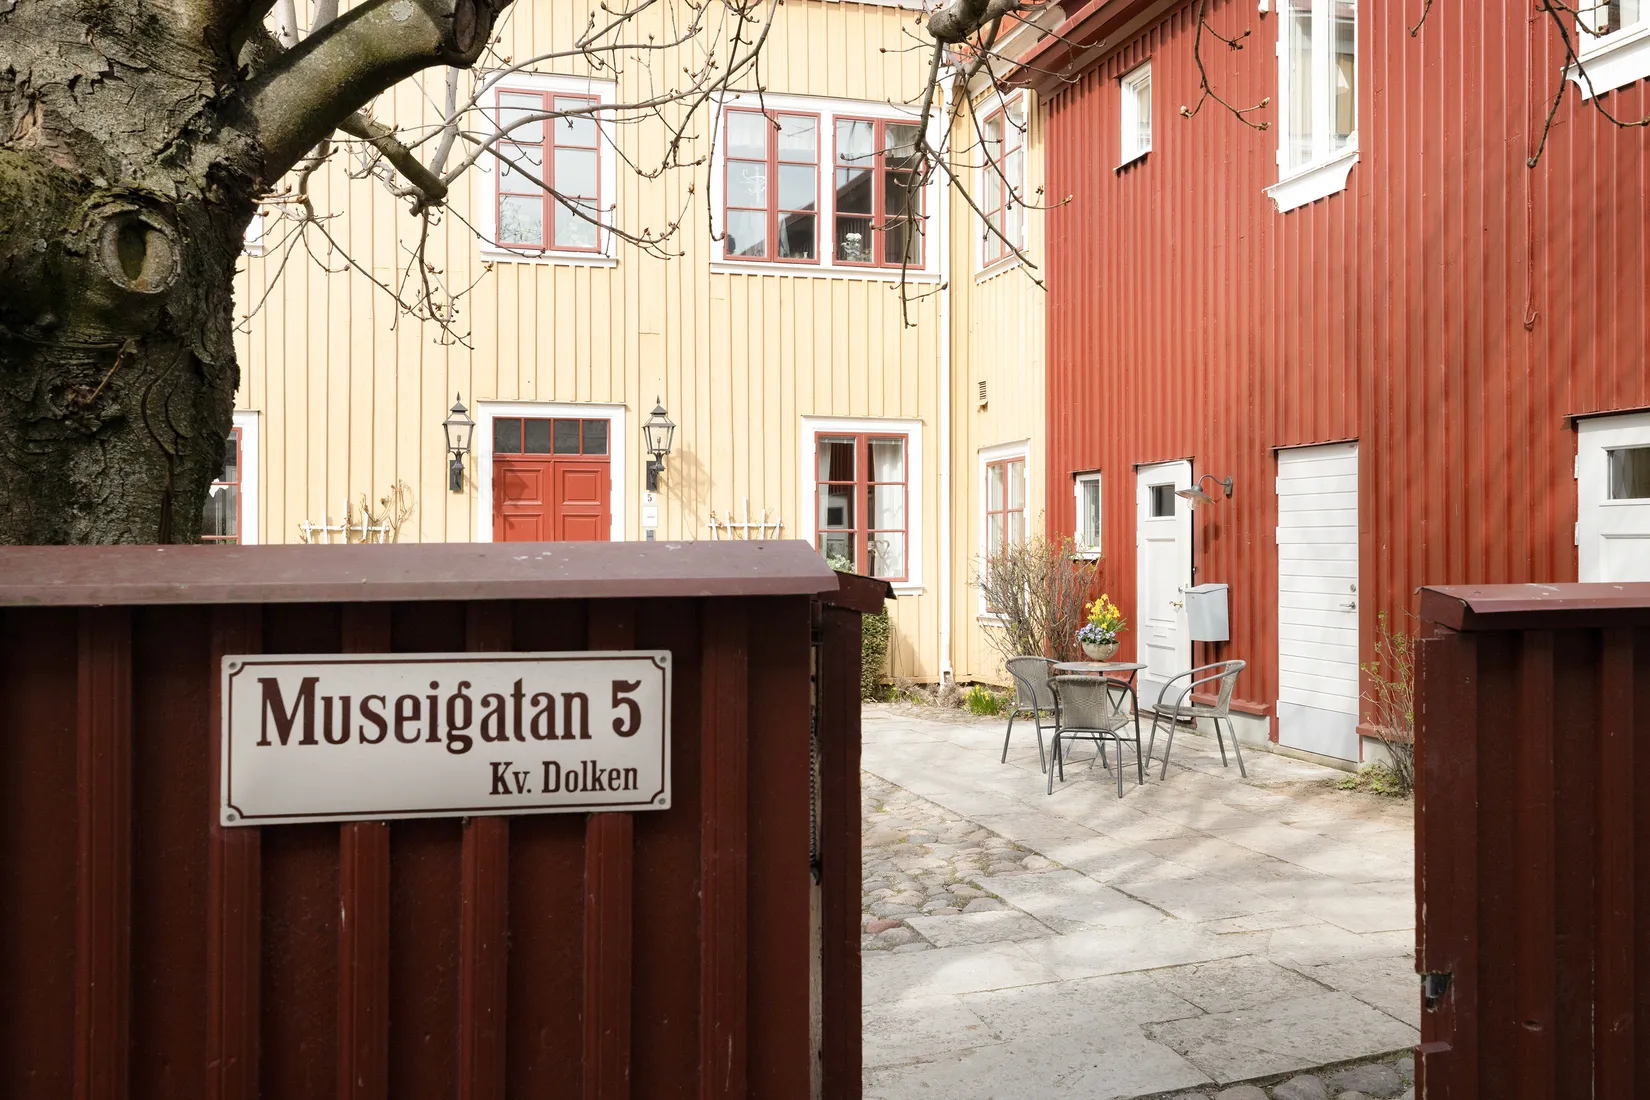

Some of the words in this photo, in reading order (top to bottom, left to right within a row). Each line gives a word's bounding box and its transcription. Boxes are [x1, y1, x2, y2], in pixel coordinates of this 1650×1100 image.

[647, 493, 653, 503] 5
[256, 677, 592, 755] Museigatan
[611, 679, 642, 738] 5
[489, 761, 532, 796] Kv.
[541, 759, 639, 794] Dolken
